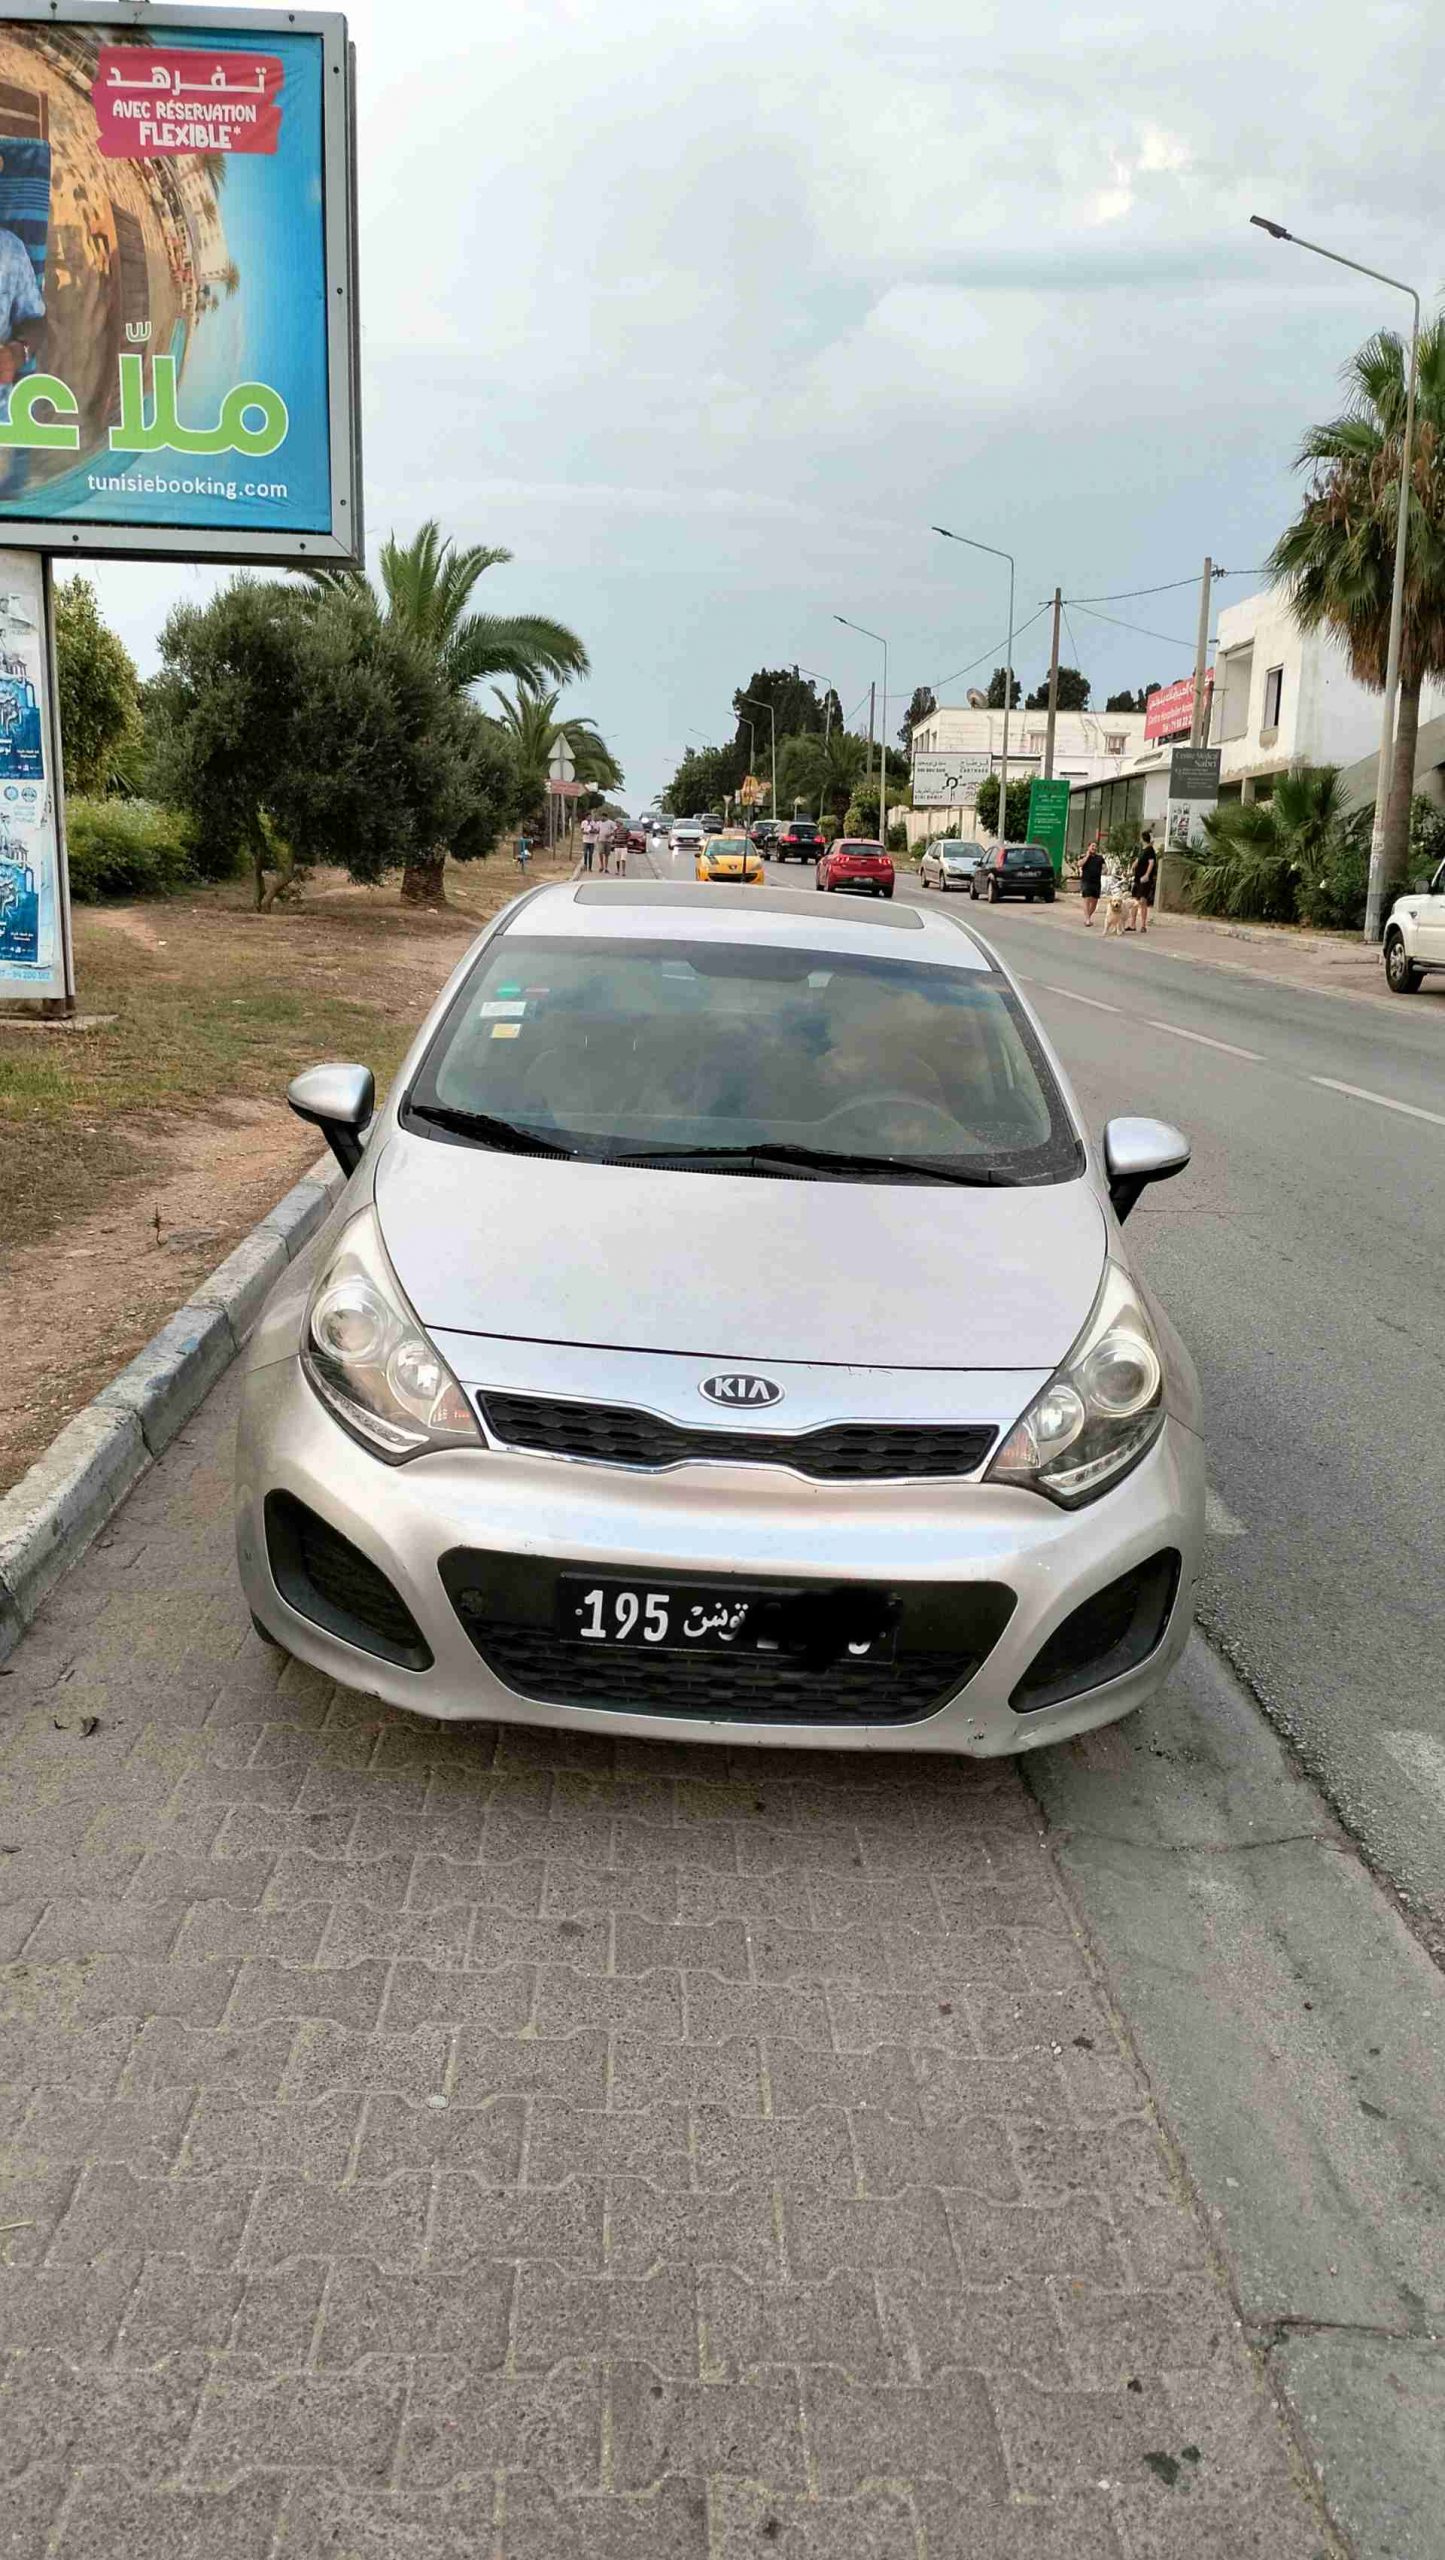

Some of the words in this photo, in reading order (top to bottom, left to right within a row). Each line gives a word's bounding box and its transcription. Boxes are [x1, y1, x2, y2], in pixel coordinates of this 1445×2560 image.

[112, 99, 151, 119] AVEC
[156, 99, 257, 123] RÉSERVATION
[87, 474, 288, 500] tunisiebooking.com
[714, 1378, 770, 1400] KIA
[580, 1589, 670, 1642] 195
[683, 1602, 749, 1641] تونس
